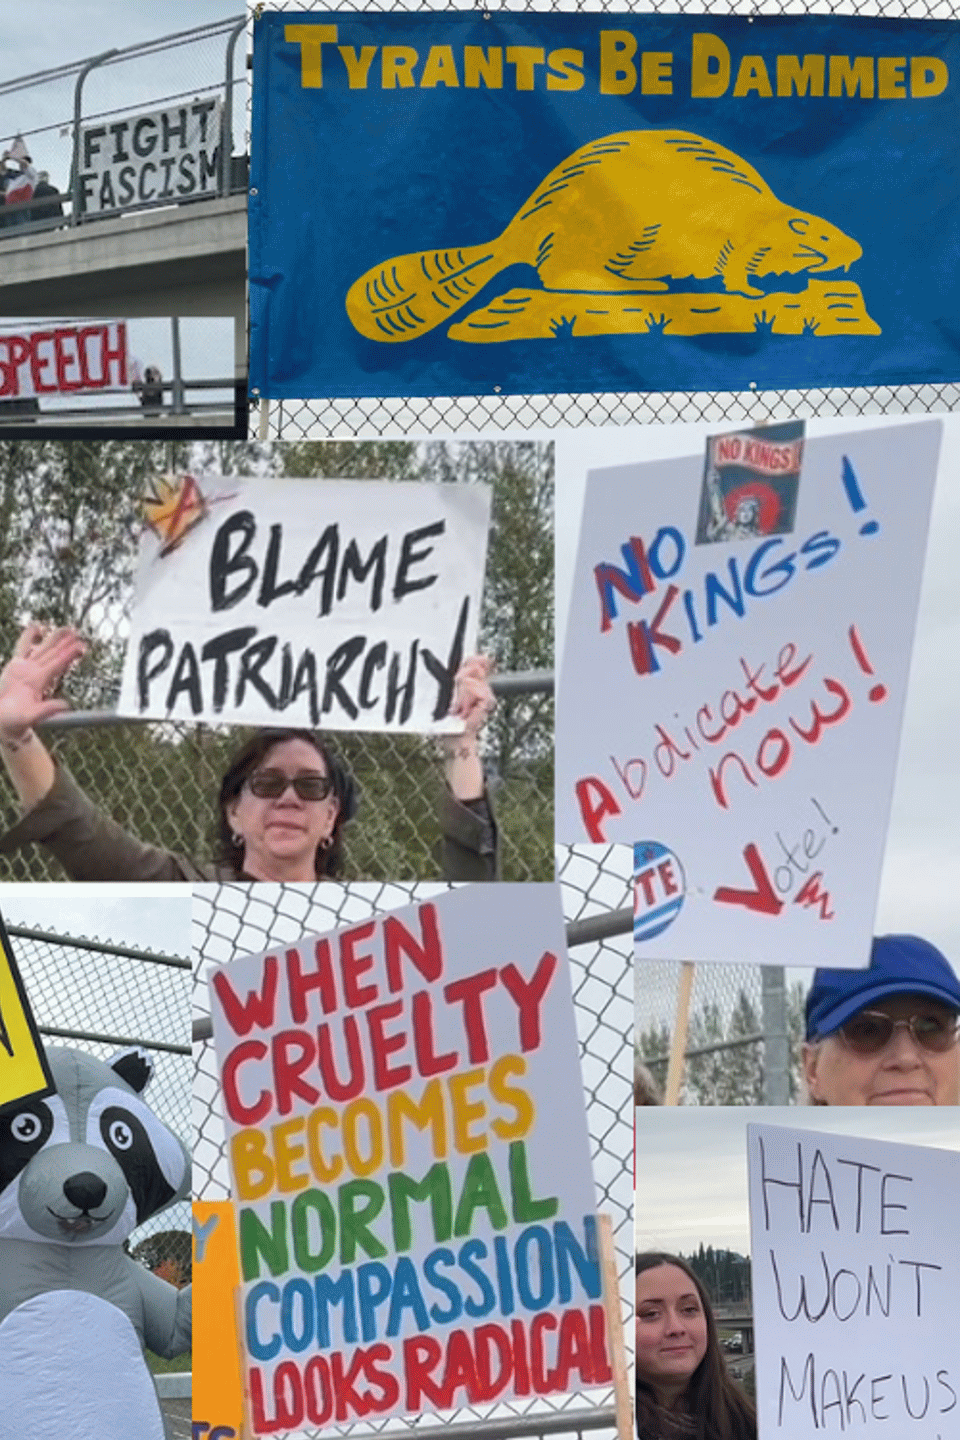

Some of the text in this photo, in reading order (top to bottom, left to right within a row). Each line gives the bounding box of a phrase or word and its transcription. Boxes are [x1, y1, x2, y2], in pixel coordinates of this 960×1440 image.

[81, 150, 222, 213] FASCISM
[84, 98, 219, 169] FIGHT
[719, 438, 741, 461] NO
[208, 510, 446, 617] BLAME
[593, 526, 687, 634] NO
[626, 453, 880, 676] KINGS!
[138, 595, 471, 726] PATRIARCHY
[574, 641, 813, 843] Abdicate
[211, 901, 448, 1041] WHEN
[220, 950, 558, 1127] CRUELTY
[231, 1053, 536, 1204] BECOMES
[758, 1135, 914, 1236] HATE
[239, 1140, 559, 1283] NORMAL
[243, 1215, 603, 1365] COMPASSION
[248, 1304, 613, 1436] LOOKS RADICAL
[777, 1352, 959, 1431] MAKE US
